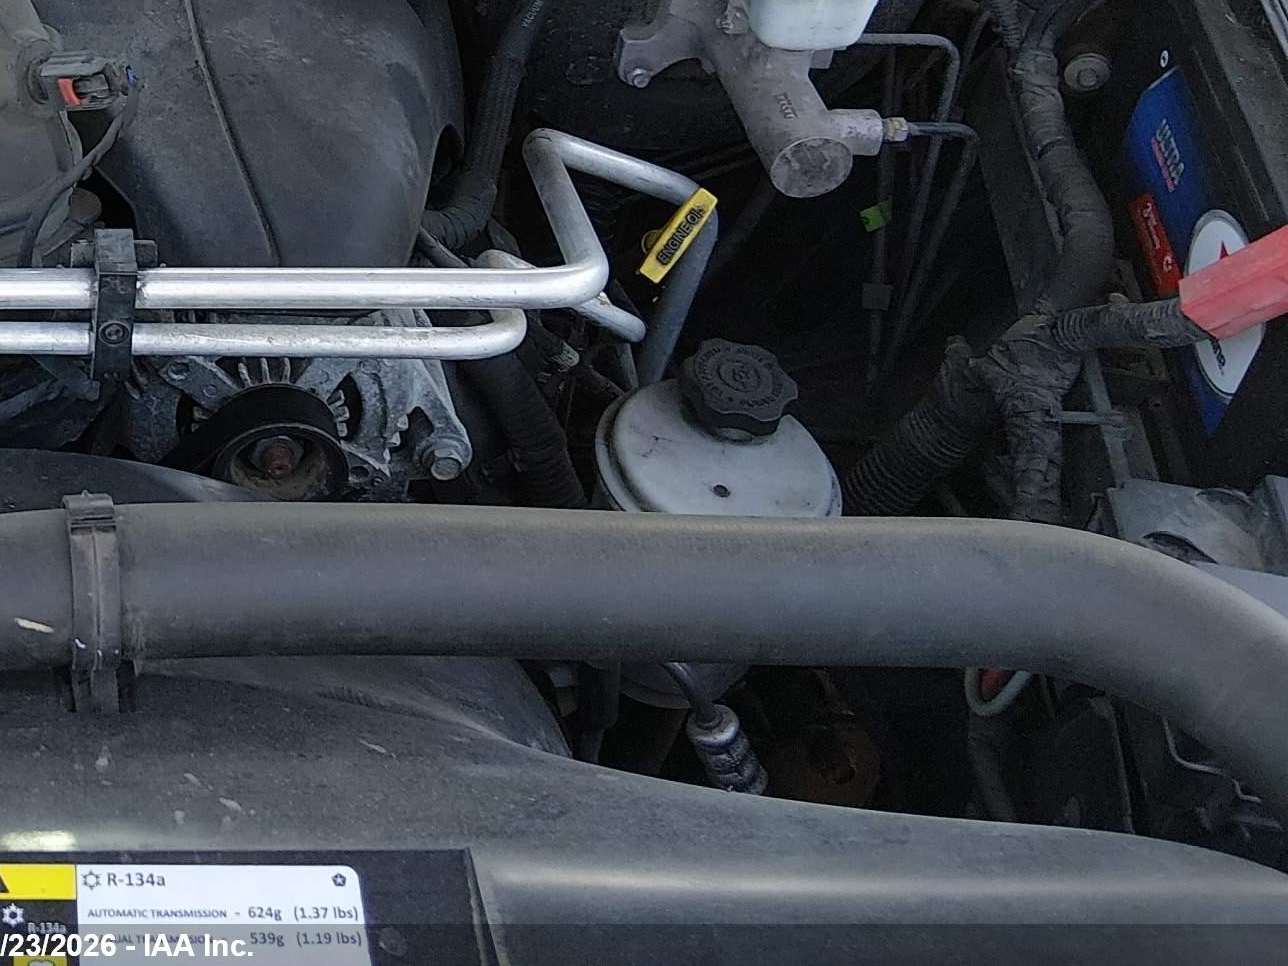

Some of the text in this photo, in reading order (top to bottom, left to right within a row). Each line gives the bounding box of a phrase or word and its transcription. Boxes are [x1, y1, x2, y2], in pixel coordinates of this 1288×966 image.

[1156, 118, 1185, 186] ULTRA
[656, 205, 705, 265] ENGINE OIL
[107, 873, 166, 886] R-134a
[88, 908, 148, 918] AUTOMATIC
[151, 908, 227, 918] TRANSMISSION
[248, 906, 282, 921] 624g
[294, 906, 328, 921] (1.37
[333, 906, 359, 921] lbs)
[28, 922, 67, 934] R-134a
[250, 932, 285, 946] 539g
[296, 931, 332, 946] (1.19
[337, 931, 362, 946] lbs)
